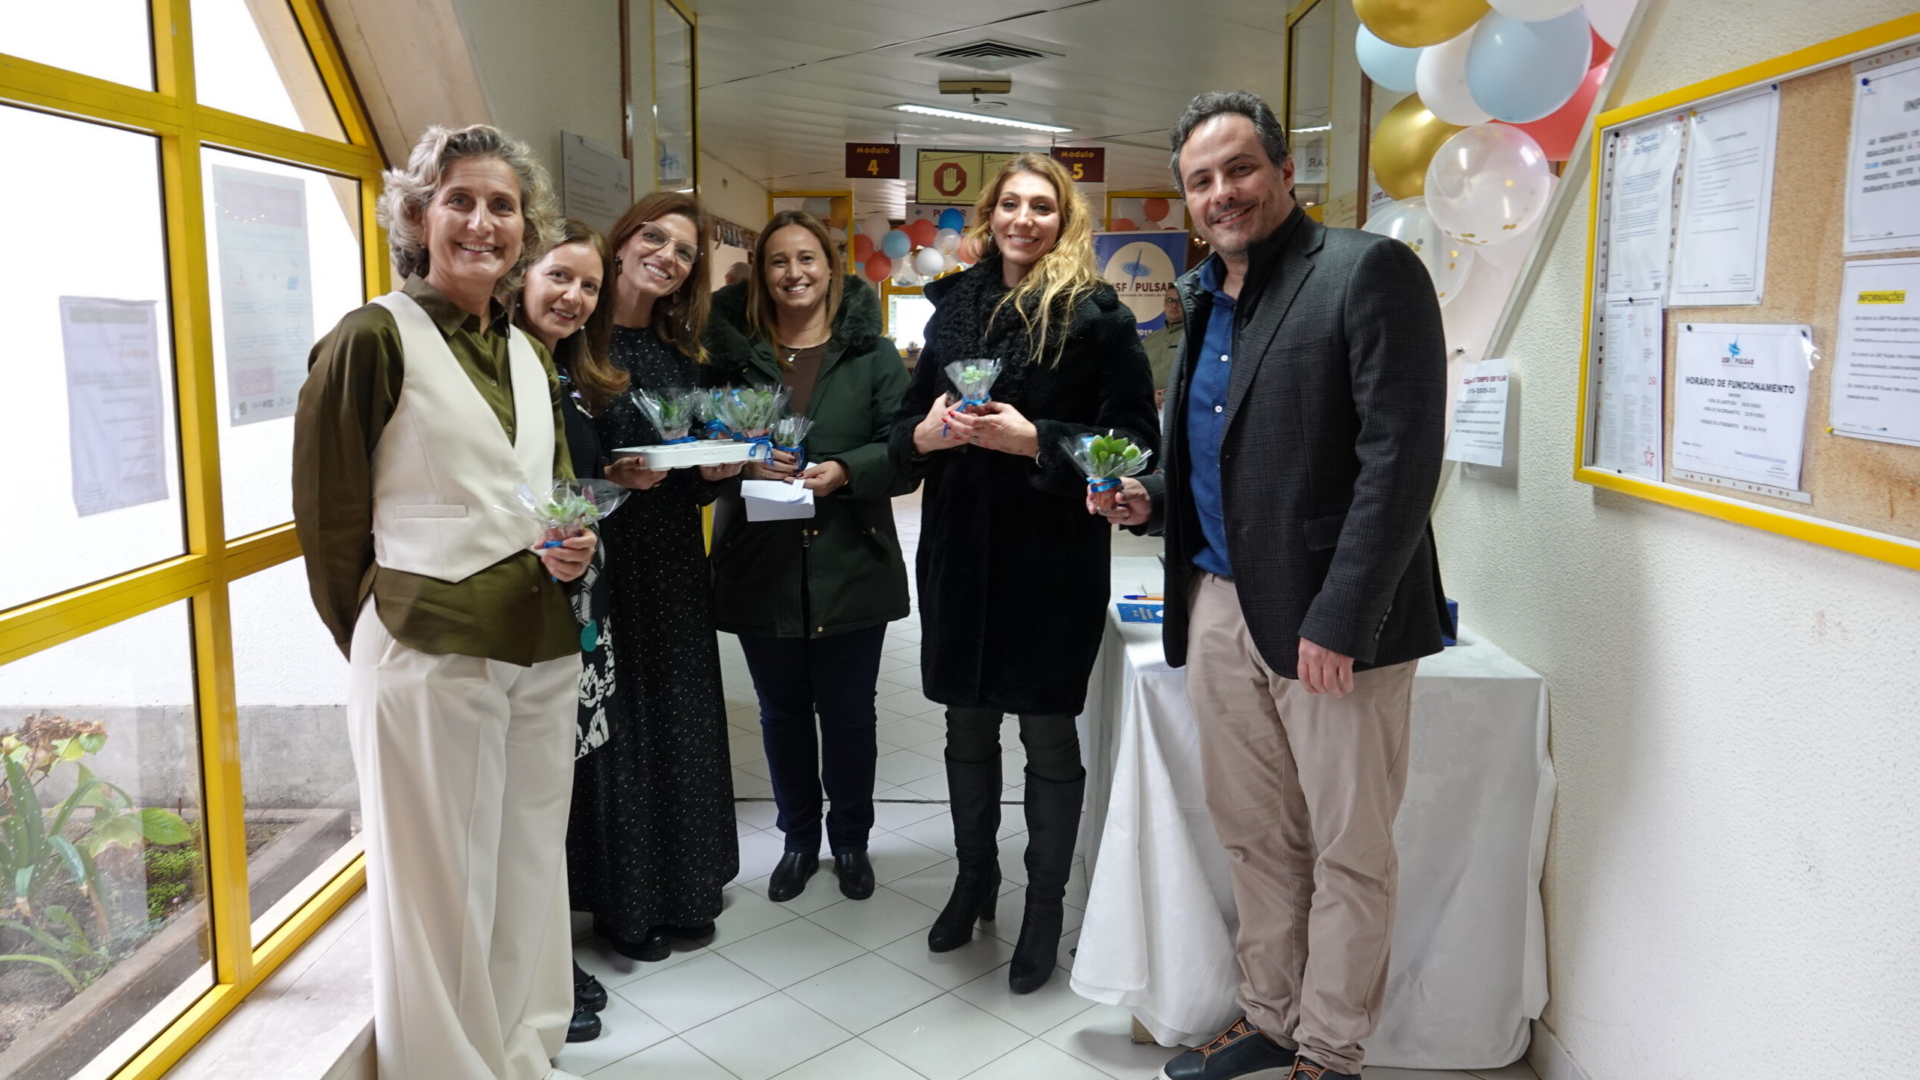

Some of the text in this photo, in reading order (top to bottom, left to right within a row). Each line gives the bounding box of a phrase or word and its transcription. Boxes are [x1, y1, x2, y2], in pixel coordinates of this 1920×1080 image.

[867, 159, 879, 176] 4
[1072, 163, 1084, 179] 5
[1115, 282, 1127, 292] SF
[1685, 376, 1795, 394] HORÁRIO DE FUNCIONAMENTO
